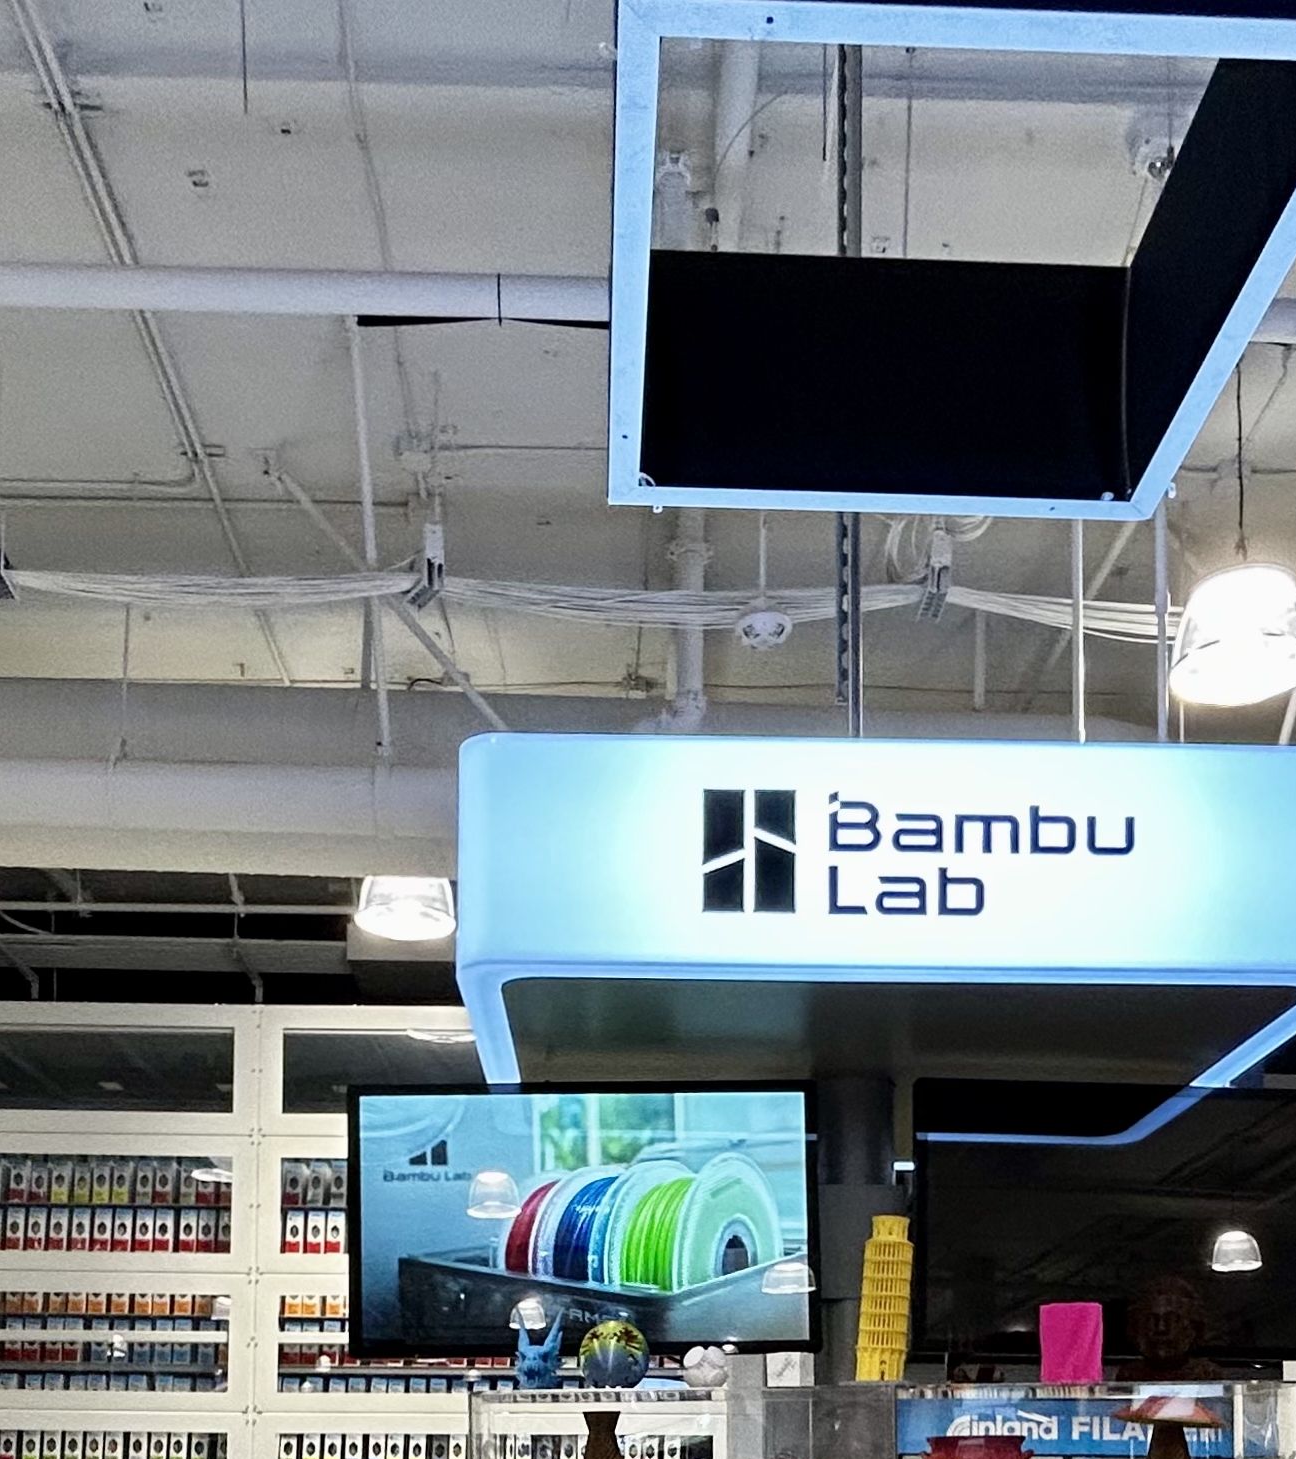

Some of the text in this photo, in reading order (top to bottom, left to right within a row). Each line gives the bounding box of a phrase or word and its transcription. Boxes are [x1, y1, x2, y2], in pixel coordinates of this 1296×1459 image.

[828, 790, 1135, 855] Bambu
[828, 865, 985, 916] Lab
[383, 1169, 441, 1183] Bambu
[971, 1414, 1059, 1441] inland
